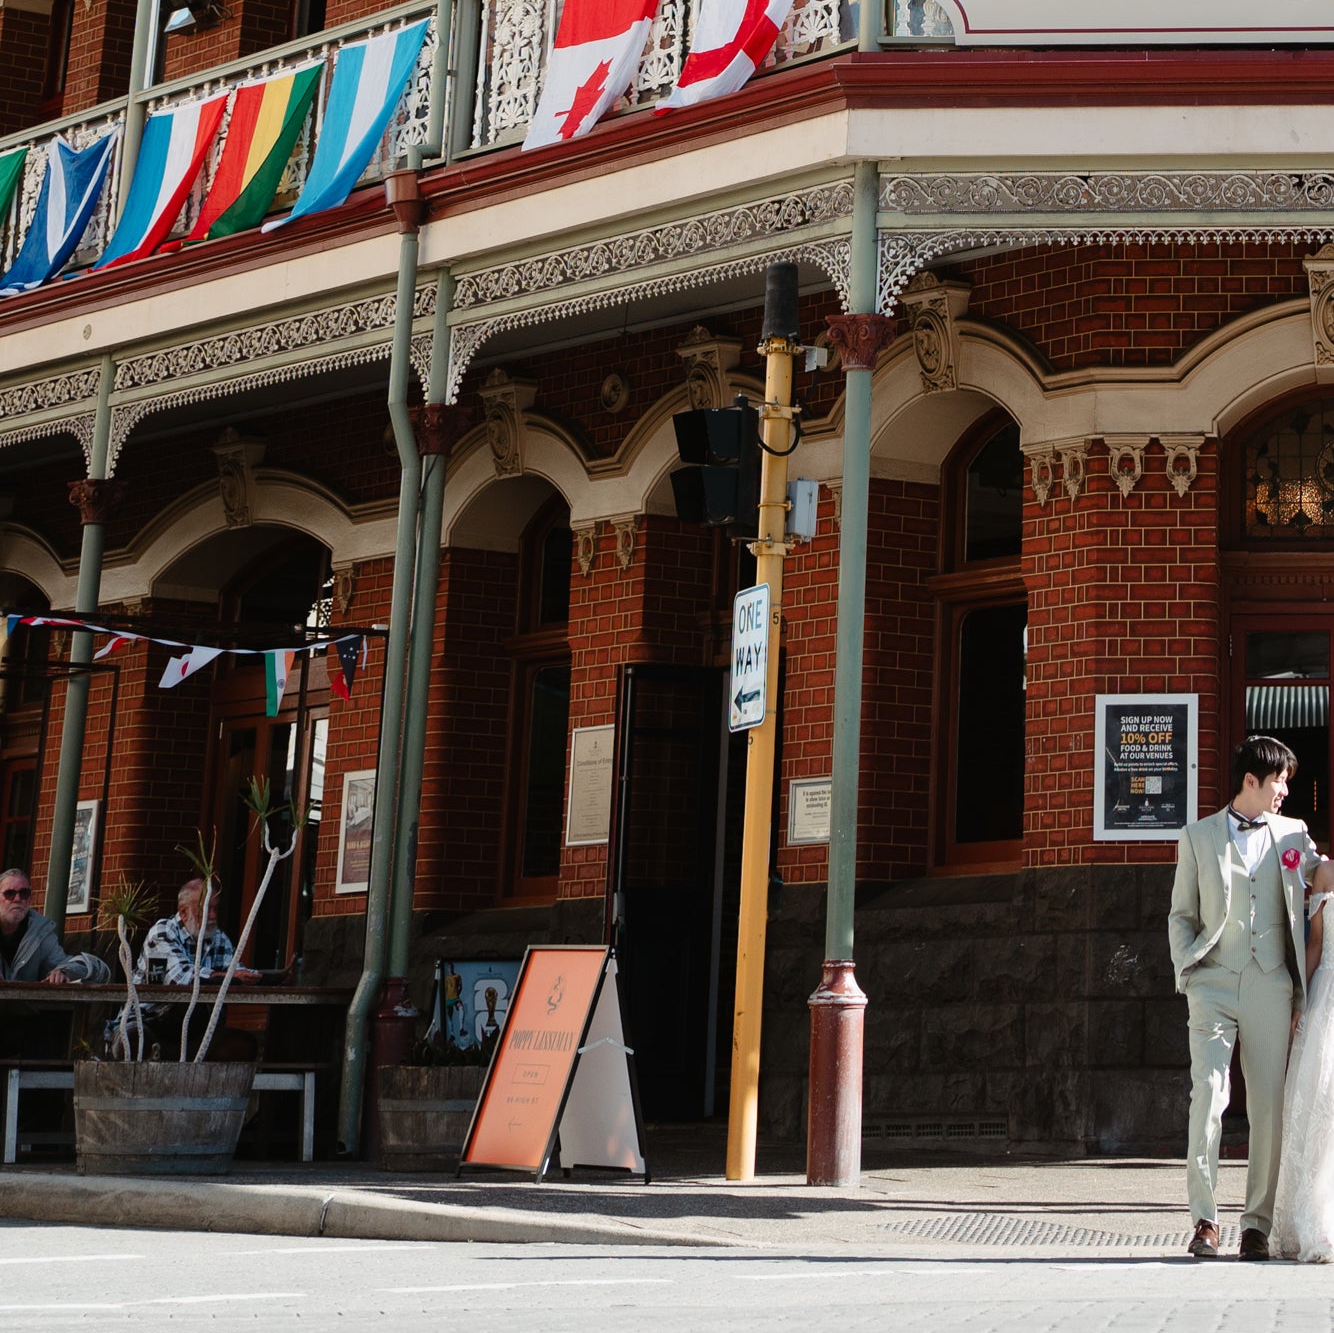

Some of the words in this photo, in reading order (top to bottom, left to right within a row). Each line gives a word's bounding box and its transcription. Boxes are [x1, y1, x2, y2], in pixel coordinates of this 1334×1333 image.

[738, 600, 763, 634] ONE
[772, 611, 780, 625] 5
[735, 641, 763, 678] WAY
[1121, 716, 1140, 724] SIGN
[1141, 716, 1153, 724] UP
[1154, 716, 1173, 724] NOW
[1121, 724, 1139, 732] AND
[1140, 724, 1173, 732] RECEIVE
[1120, 733, 1146, 744] 10%
[1149, 733, 1173, 744] OFF
[1120, 744, 1141, 752] FOOD
[509, 1030, 533, 1050] POPPY
